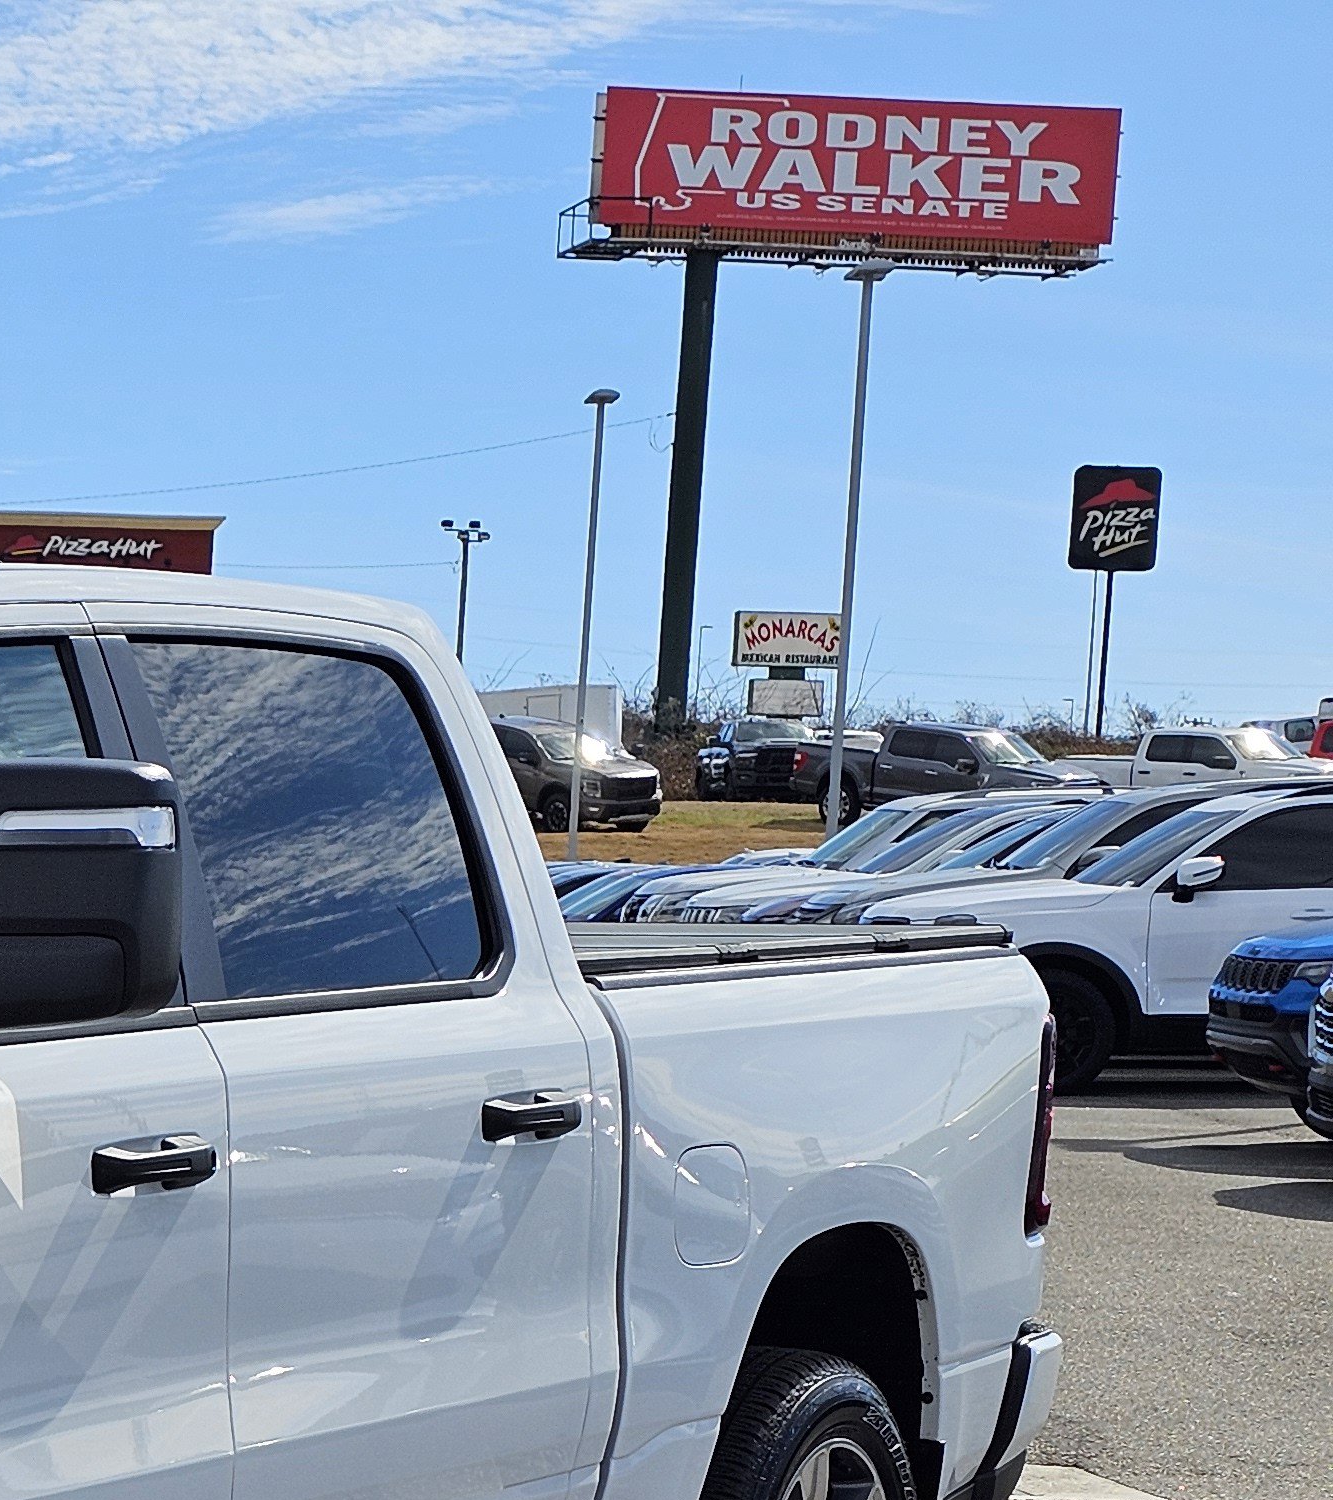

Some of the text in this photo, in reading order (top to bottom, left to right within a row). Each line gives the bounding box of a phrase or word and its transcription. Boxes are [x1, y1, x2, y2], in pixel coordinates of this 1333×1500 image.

[710, 107, 1049, 157] RODNEY
[666, 144, 1082, 206] WALKER
[736, 191, 1009, 219] US SENATE
[1079, 502, 1156, 541] Pizza
[1092, 523, 1148, 552] Hut
[42, 535, 164, 559] Pizza Hut
[744, 617, 840, 652] MONARCAS
[741, 653, 781, 663] MEXICAN
